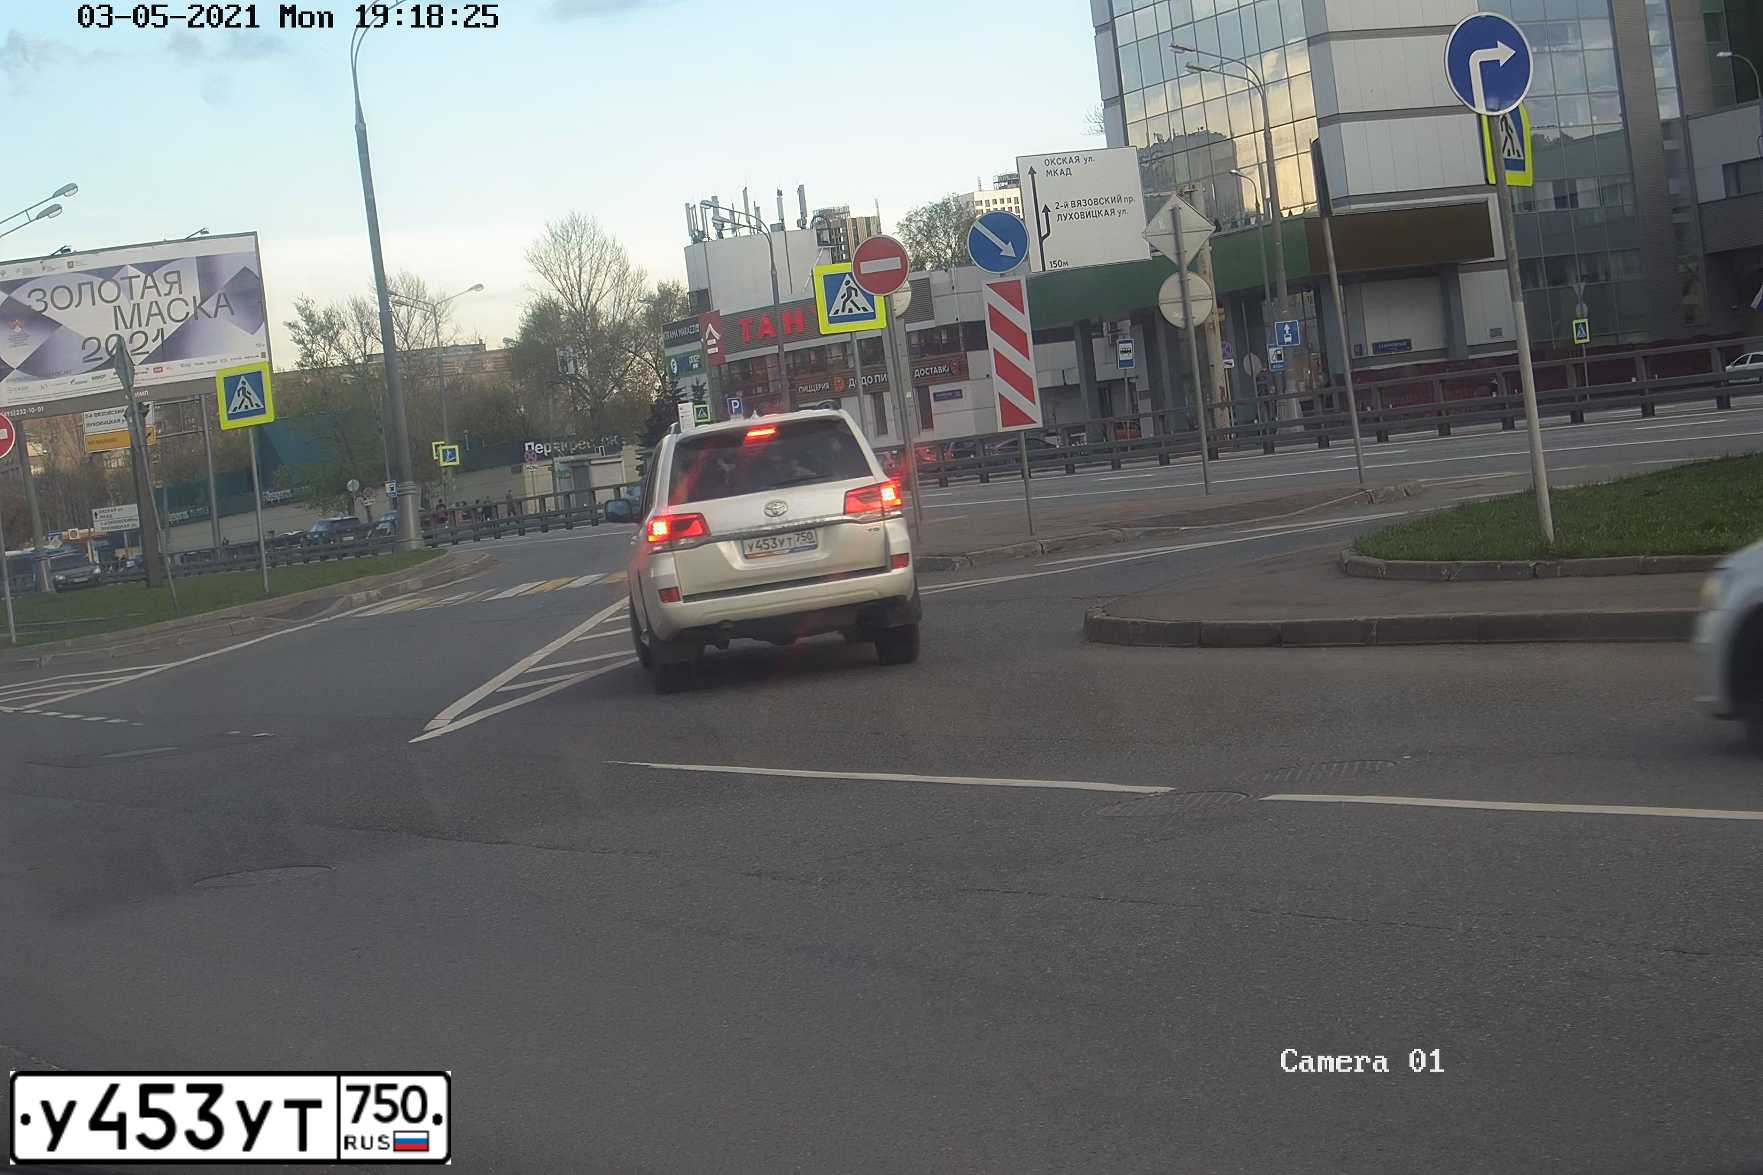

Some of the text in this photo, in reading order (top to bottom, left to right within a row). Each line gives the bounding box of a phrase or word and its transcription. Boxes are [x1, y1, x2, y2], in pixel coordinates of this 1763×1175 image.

[1044, 156, 1095, 166] ОКСКАЯ ул.
[1045, 168, 1072, 177] МКАД
[1055, 194, 1136, 210] 2-й ВЯЗОВСКИЙ пр.
[1056, 208, 1129, 222] ЛУХОВИЦКАЯ ул.
[1049, 260, 1069, 269] 150м
[27, 270, 183, 314] ЗОЛОТАЯ
[113, 293, 236, 331] МАСКА
[737, 306, 817, 343] ТАН
[81, 328, 165, 364] 2021
[798, 382, 830, 394] ПИЦЦЕРИЯ
[794, 531, 814, 543] 750
